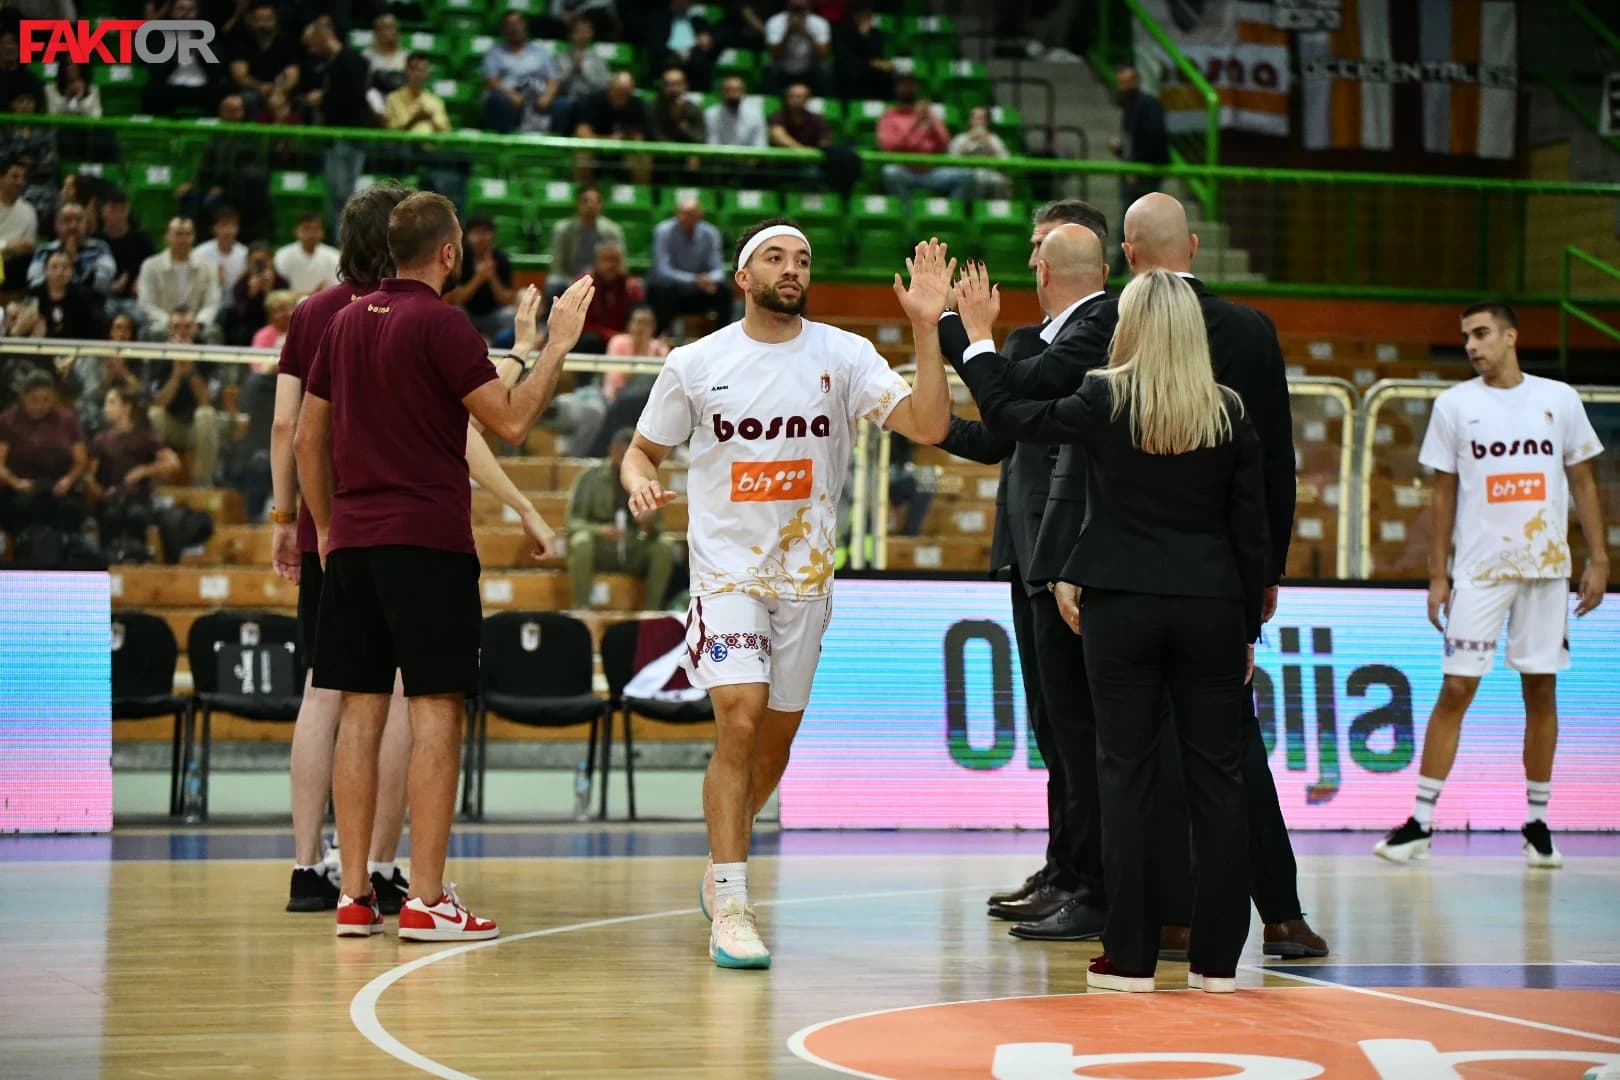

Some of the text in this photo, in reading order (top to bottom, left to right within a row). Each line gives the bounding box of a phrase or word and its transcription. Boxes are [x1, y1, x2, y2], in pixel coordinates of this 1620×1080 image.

[713, 413, 830, 442] bosna
[1471, 439, 1554, 460] bosna
[738, 472, 772, 492] bh
